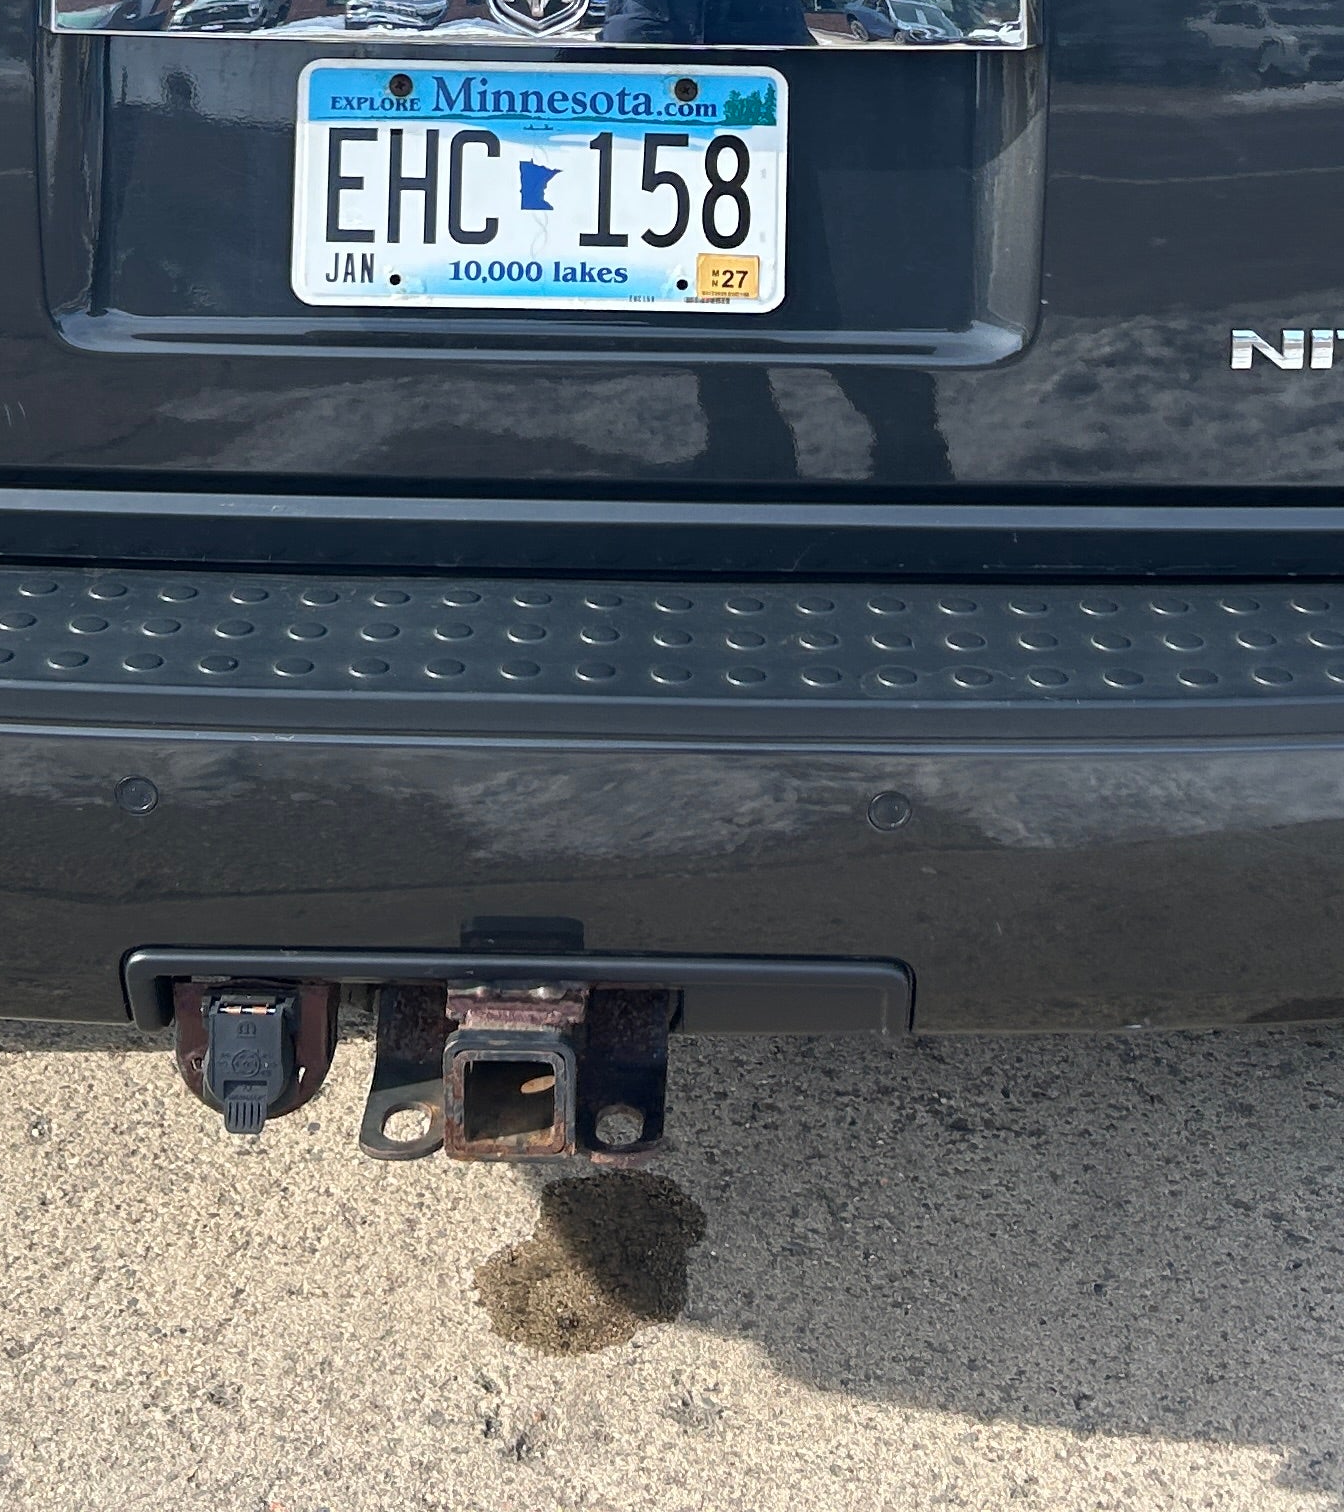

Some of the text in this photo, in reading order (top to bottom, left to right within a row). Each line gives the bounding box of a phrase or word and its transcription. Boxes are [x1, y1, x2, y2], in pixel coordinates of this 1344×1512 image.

[330, 76, 717, 117] EXPLORE Minnesota.com
[325, 127, 751, 249] EHC 158
[325, 252, 375, 283] JAN
[448, 259, 628, 284] 10,000 lakes
[721, 270, 749, 289] 27
